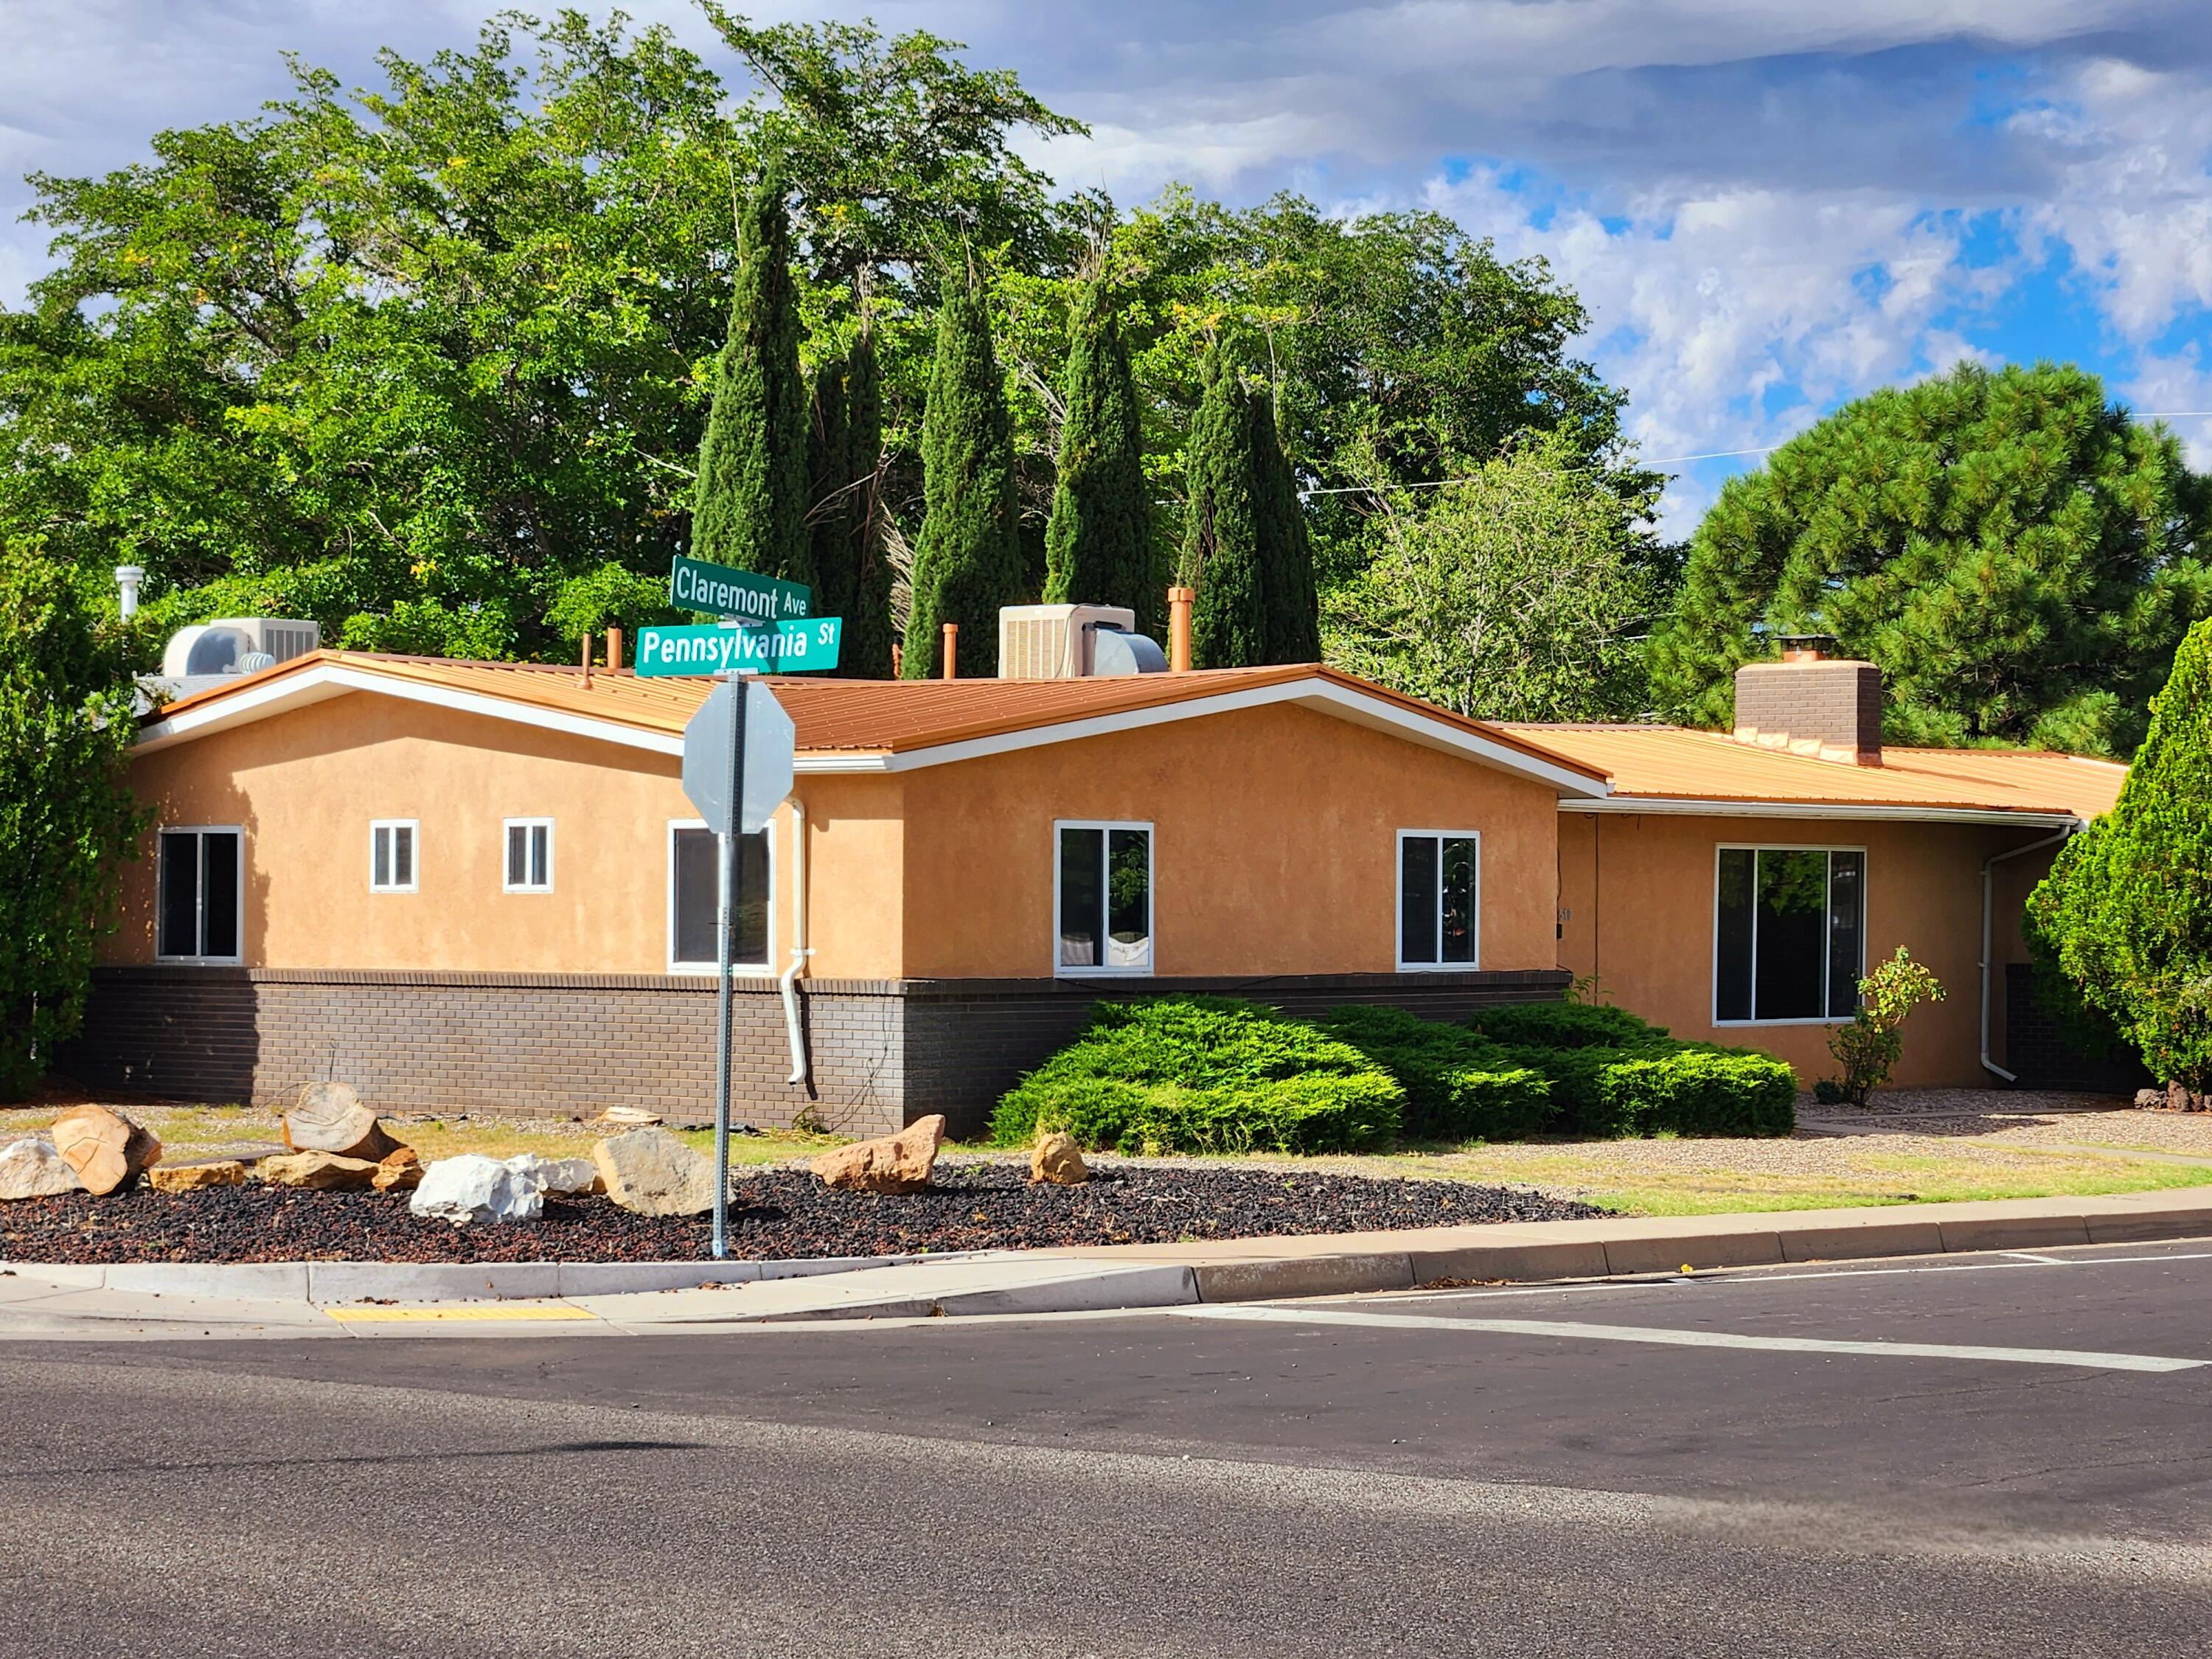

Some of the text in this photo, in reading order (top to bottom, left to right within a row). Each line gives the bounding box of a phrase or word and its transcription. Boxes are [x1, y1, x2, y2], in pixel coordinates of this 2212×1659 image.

[676, 566, 807, 619] Claremont Ave
[643, 622, 835, 668] Pennsylvania St
